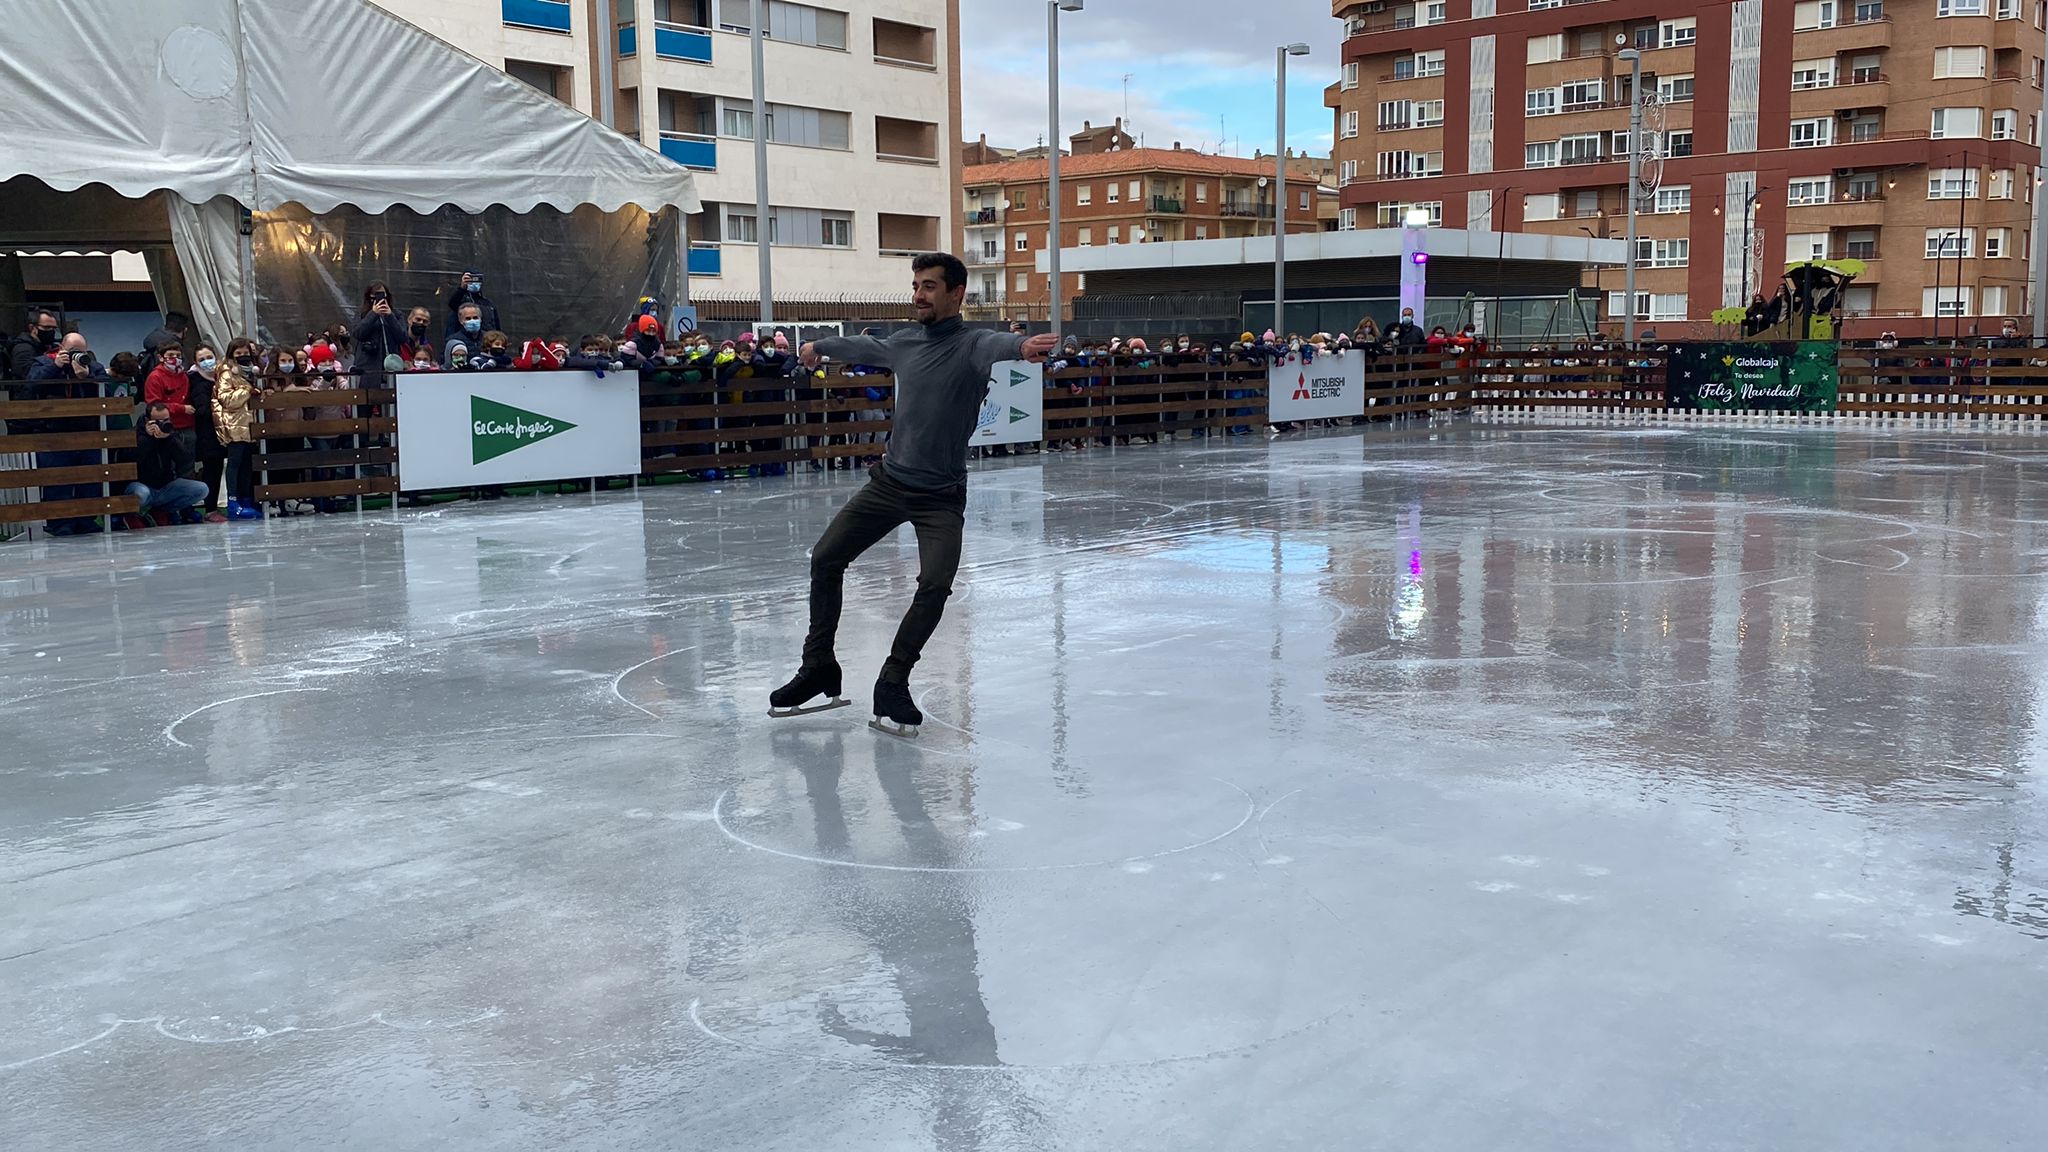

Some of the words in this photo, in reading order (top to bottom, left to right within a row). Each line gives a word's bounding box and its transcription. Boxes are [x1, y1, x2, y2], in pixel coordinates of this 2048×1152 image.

[1735, 357, 1779, 369] Globalcaja
[1312, 377, 1345, 388] MITSUBISHI
[1311, 388, 1341, 398] ELECTRIC
[1740, 383, 1802, 399] Navidad!
[473, 420, 487, 436] El
[487, 420, 515, 435] Corte
[515, 416, 554, 439] Inglés
